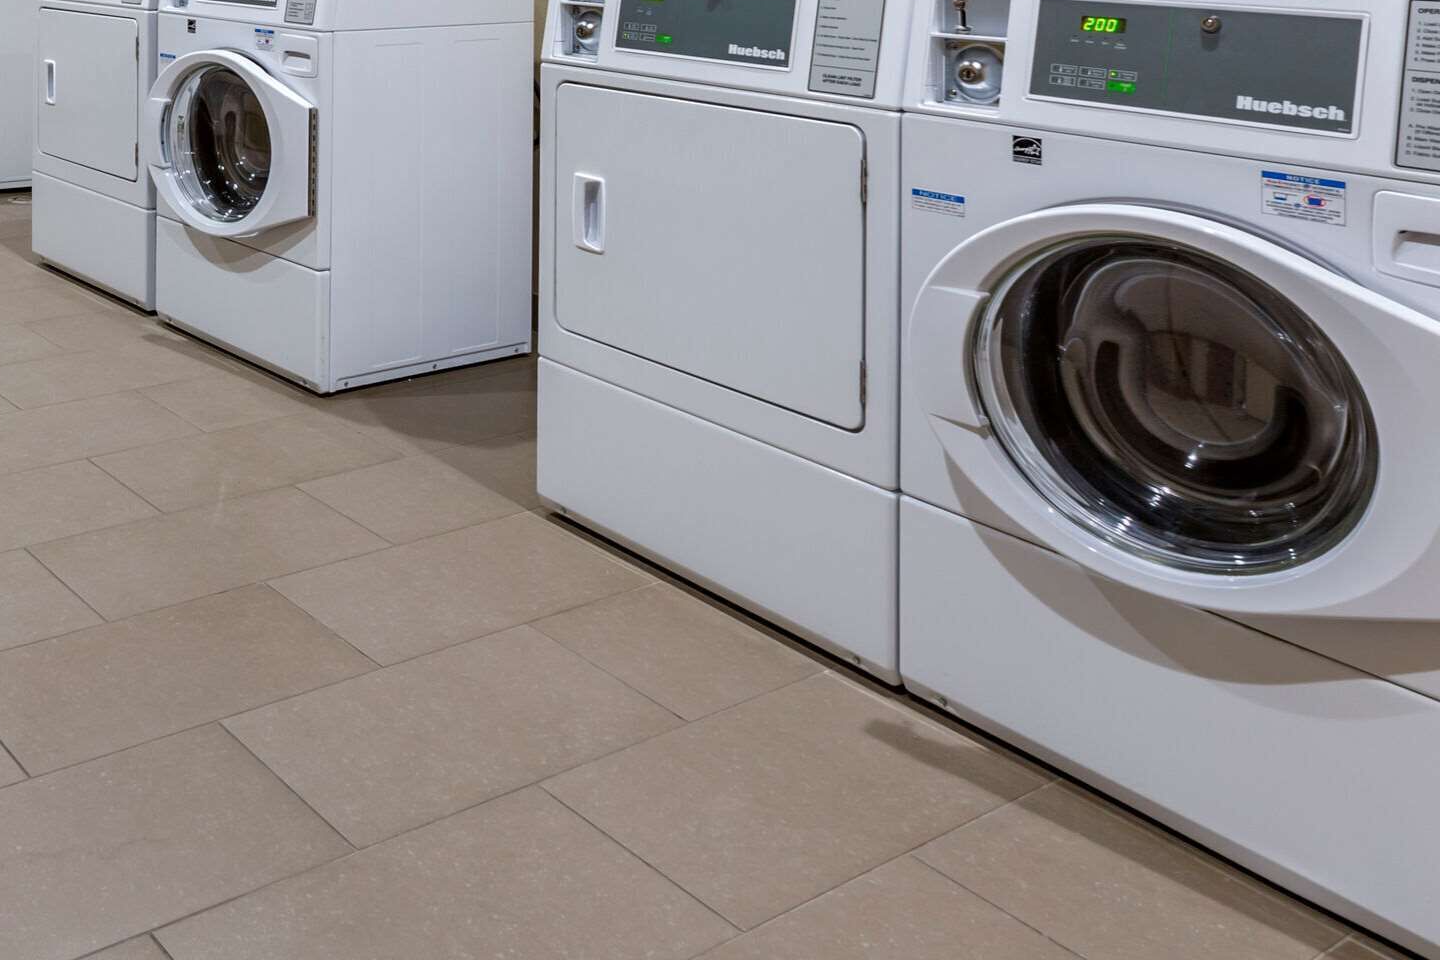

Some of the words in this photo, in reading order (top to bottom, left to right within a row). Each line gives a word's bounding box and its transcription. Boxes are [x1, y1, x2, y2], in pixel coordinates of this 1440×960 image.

[1083, 17, 1118, 32] 200
[727, 43, 785, 61] Huebsch
[1235, 95, 1345, 121] Huebsch
[1285, 175, 1320, 185] NOTICE
[919, 189, 956, 202] NOTICE
